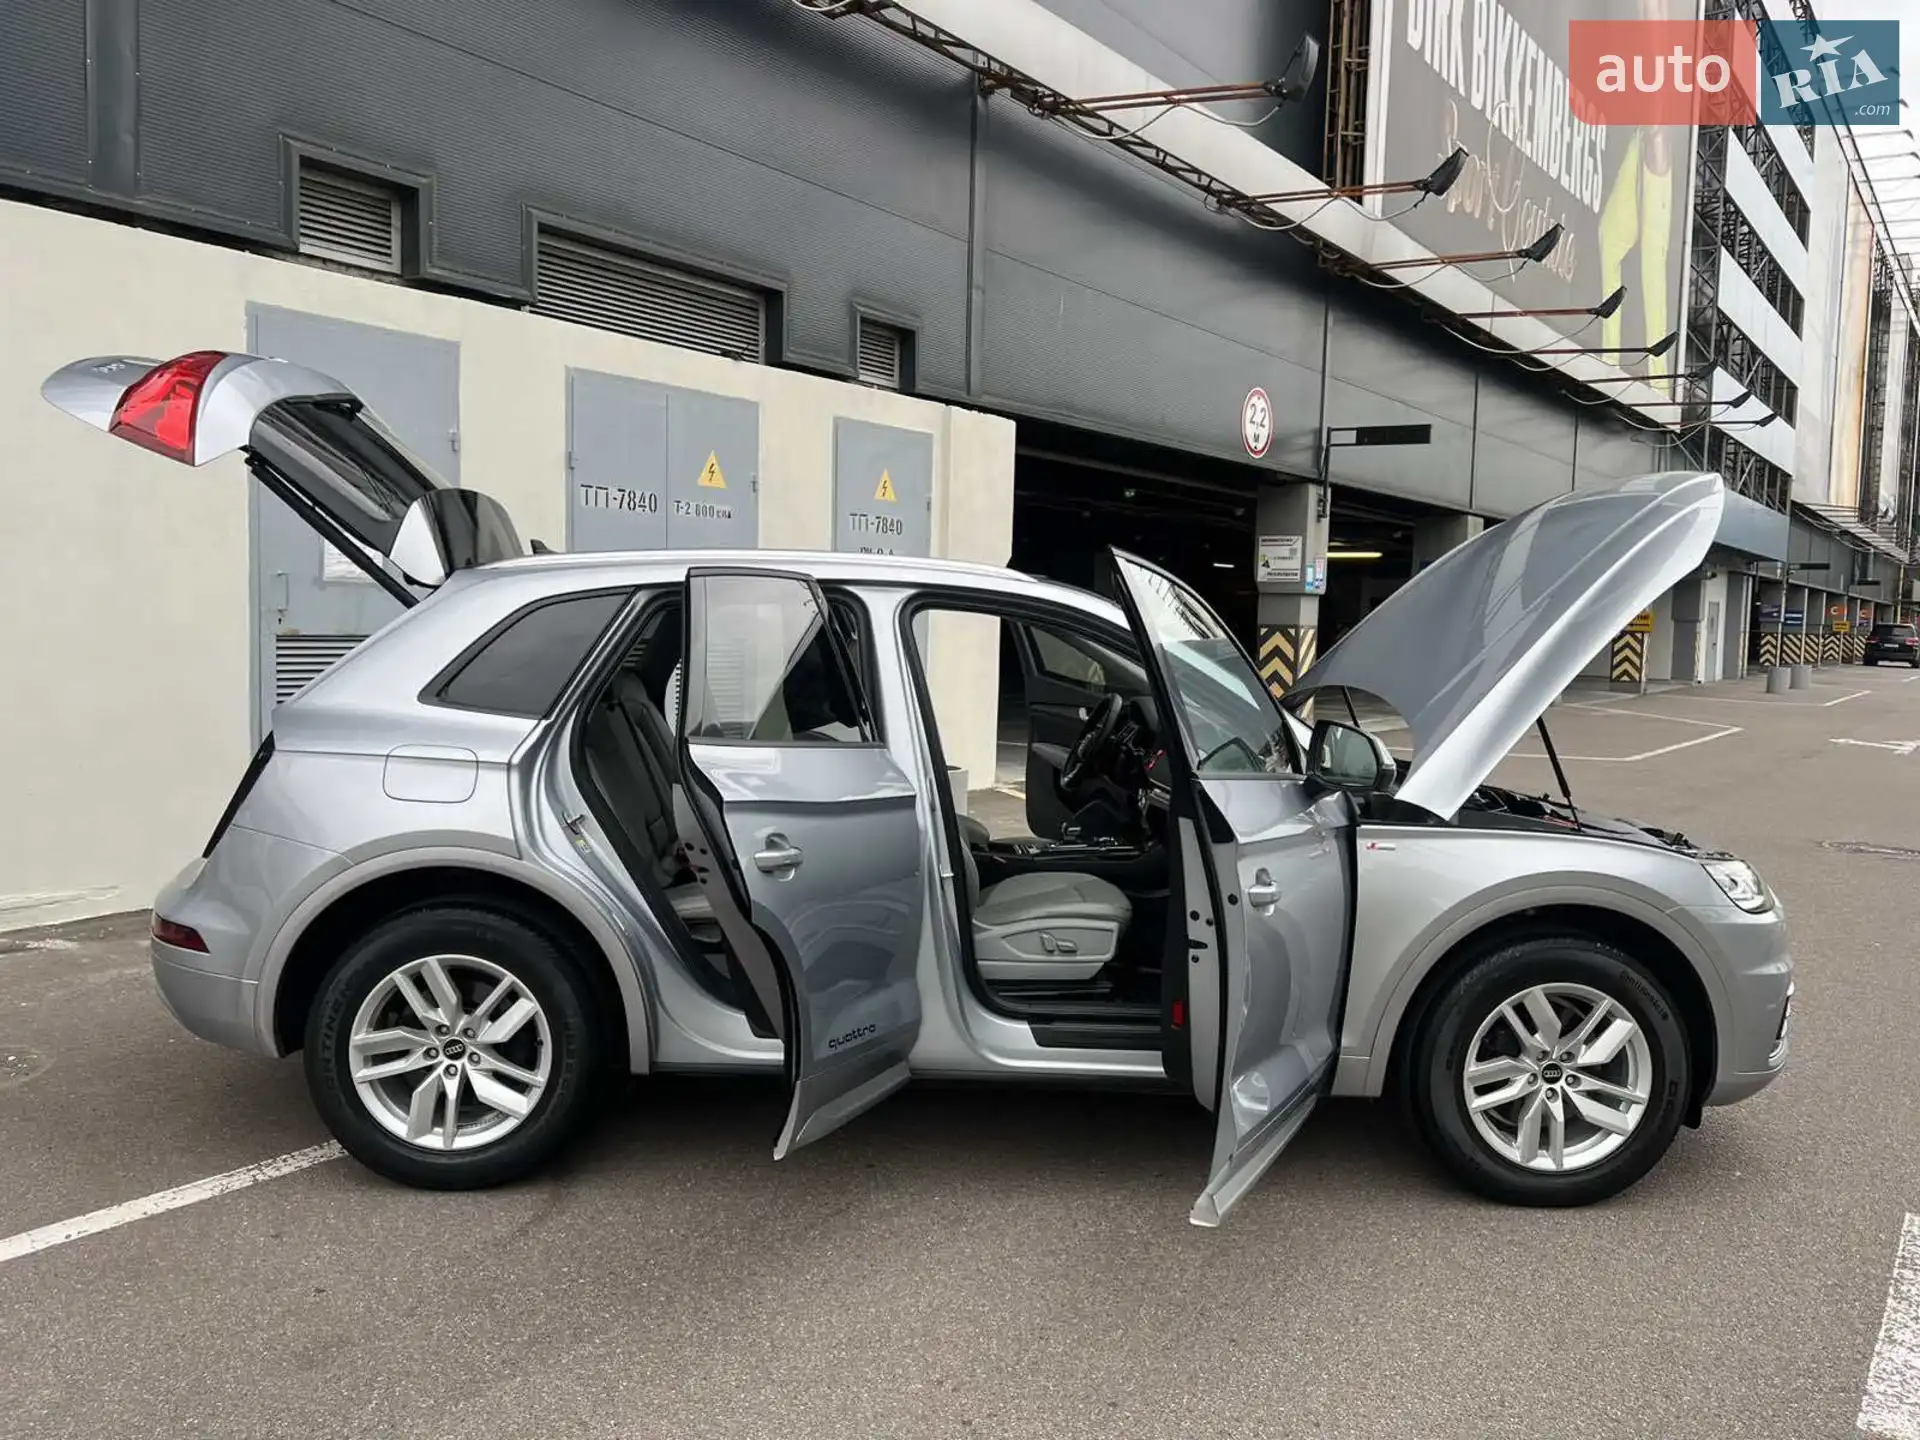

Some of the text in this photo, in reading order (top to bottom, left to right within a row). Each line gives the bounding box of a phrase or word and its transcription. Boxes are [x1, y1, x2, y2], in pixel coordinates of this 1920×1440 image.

[1470, 0, 1606, 214] BIKKEMBERGS
[1249, 403, 1267, 429] 2,2
[580, 484, 658, 513] ТП-7840
[849, 513, 903, 535] ТП-7840
[828, 1023, 877, 1050] quattro
